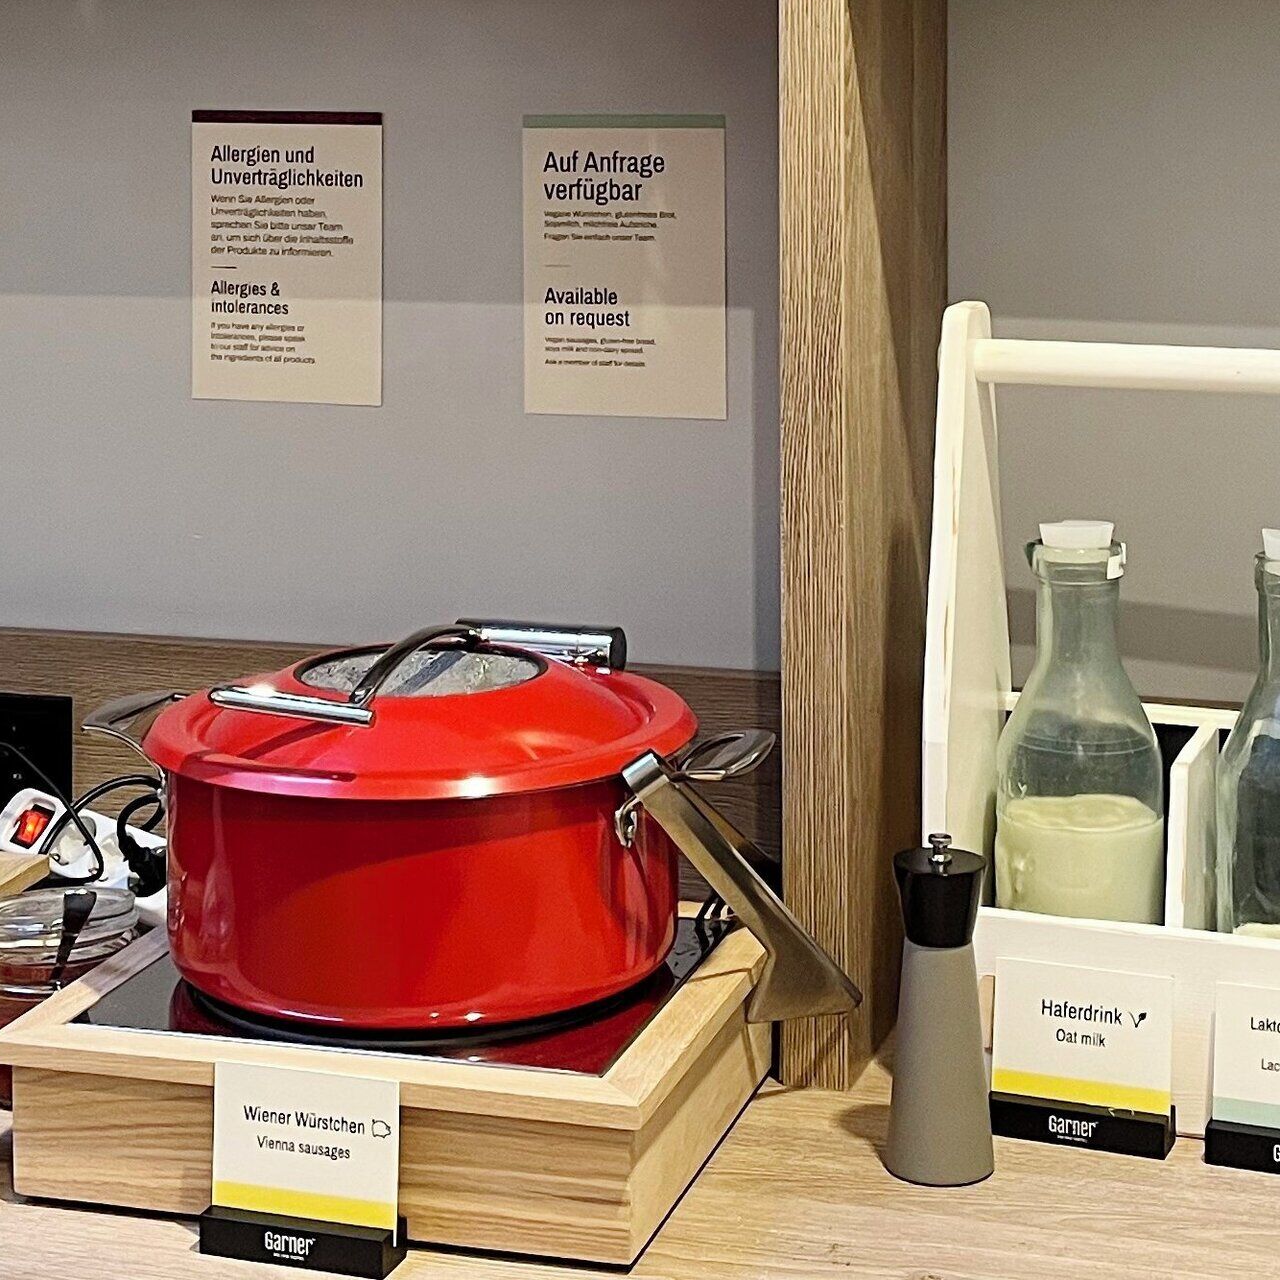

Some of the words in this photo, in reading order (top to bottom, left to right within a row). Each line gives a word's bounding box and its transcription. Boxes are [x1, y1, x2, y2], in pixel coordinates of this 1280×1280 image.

[211, 145, 280, 166] Allergien
[285, 146, 315, 163] und
[543, 150, 579, 173] Auf
[583, 150, 665, 178] Anfrage
[211, 168, 363, 189] Unverträglichkeiten
[295, 196, 315, 205] oder
[543, 178, 643, 206] verfügbar
[211, 281, 266, 298] Allergies
[270, 282, 280, 296] &
[544, 287, 618, 305] Available
[211, 299, 289, 315] intolerances
[545, 311, 564, 325] on
[570, 311, 630, 329] request
[1041, 999, 1123, 1026] Haferdrink
[1056, 1028, 1078, 1044] Oat
[1081, 1032, 1106, 1048] milk
[243, 1105, 291, 1126] Wiener
[295, 1111, 365, 1135] Würstchen
[1048, 1115, 1096, 1138] Garner
[257, 1135, 295, 1153] Vienna
[298, 1142, 351, 1161] sausages
[265, 1231, 314, 1256] Garner
